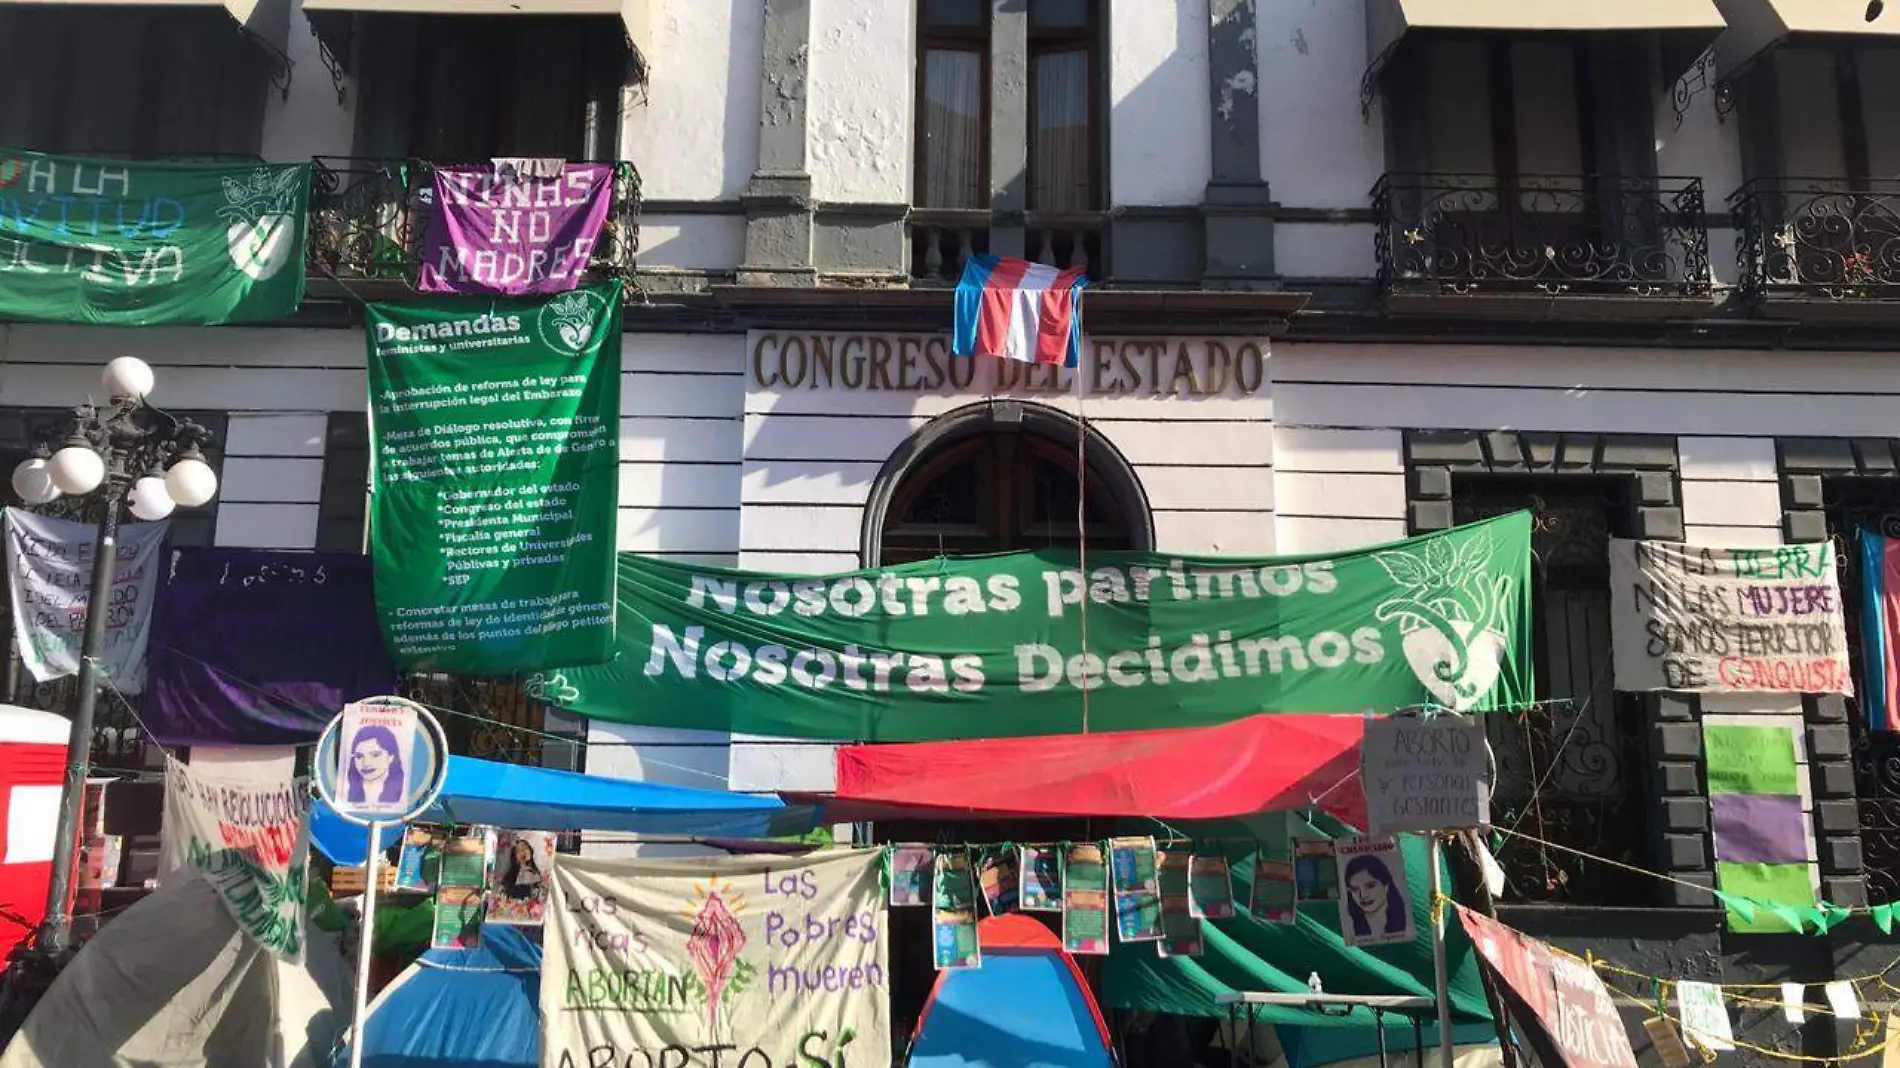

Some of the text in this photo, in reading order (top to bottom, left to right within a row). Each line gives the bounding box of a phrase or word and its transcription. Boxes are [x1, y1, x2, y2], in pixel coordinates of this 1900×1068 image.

[0, 196, 187, 239] VITUD
[489, 209, 550, 245] NO
[438, 238, 595, 284] MADRES
[376, 314, 521, 343] Demandas
[376, 335, 531, 358] feministas y universitarias
[753, 335, 975, 391] CONGRESO
[1092, 339, 1264, 397] ESTADO
[454, 382, 469, 393] de
[471, 380, 519, 391] reforma
[522, 377, 537, 387] de
[539, 376, 558, 387] ley
[560, 375, 587, 386] para
[380, 388, 583, 414] la interrupción legal del Embarazo
[417, 427, 431, 437] de
[434, 423, 480, 435] Diálogo
[550, 417, 573, 426] con
[381, 445, 396, 455] de
[399, 440, 451, 454] acuerdos
[506, 434, 528, 445] que
[391, 454, 438, 468] trabajar
[440, 451, 477, 462] temas
[479, 448, 494, 459] de
[497, 446, 533, 458] Alerta
[536, 444, 551, 454] de
[442, 481, 580, 500] Gobernador del estado
[442, 496, 567, 516] Congreso del estado
[443, 510, 572, 529] Presidenta Municipal
[444, 527, 541, 544] Fiscalía general
[445, 545, 499, 558] Rectores
[501, 542, 517, 553] de
[502, 559, 510, 570] y
[512, 553, 565, 568] privadas
[1681, 545, 1718, 575] LA
[447, 574, 470, 586] SEP
[686, 560, 1338, 618] Nosotras parimos
[396, 604, 458, 617] Concretar
[461, 602, 498, 613] mesas
[501, 599, 516, 609] de
[1737, 584, 1834, 616] MUJERE
[391, 620, 445, 631] reformas
[448, 617, 462, 628] de
[464, 616, 482, 628] ley
[486, 614, 501, 625] de
[393, 633, 440, 643] además
[441, 631, 455, 641] de
[458, 630, 476, 640] los
[478, 627, 522, 641] puntos
[1726, 621, 1836, 656] TERRITOR
[643, 623, 1384, 693] Nosotras Decidimos
[1663, 658, 1707, 688] DE
[1393, 728, 1471, 757] ABORTO
[764, 867, 818, 900] Las
[565, 892, 617, 915] Las
[765, 911, 877, 949] Pobres
[566, 968, 686, 1006] ABORTAN
[768, 963, 883, 994] mueren
